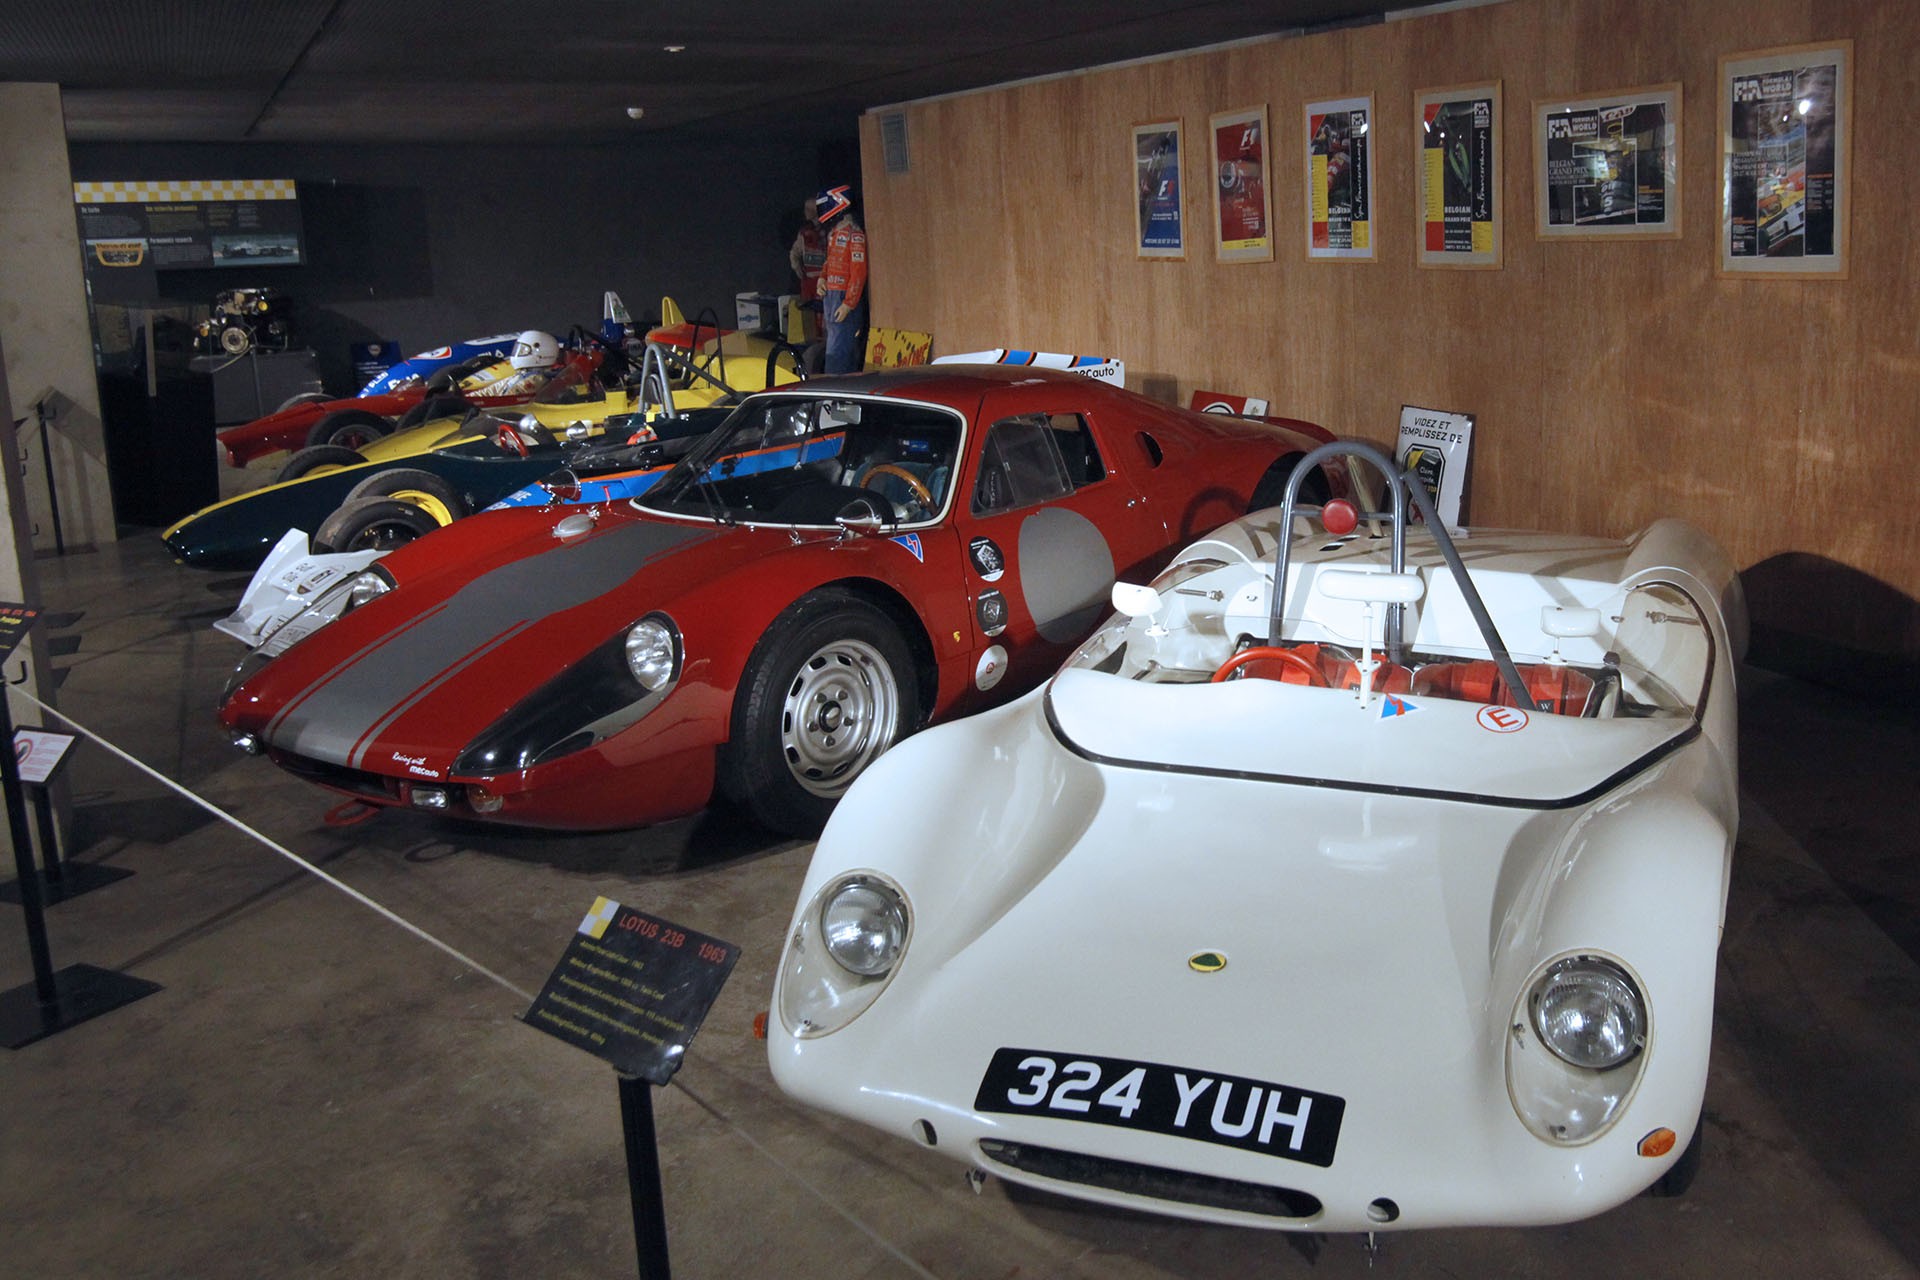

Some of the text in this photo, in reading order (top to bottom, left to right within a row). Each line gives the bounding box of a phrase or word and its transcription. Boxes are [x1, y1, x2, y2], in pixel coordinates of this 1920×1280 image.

[1734, 80, 1762, 102] FIA
[1762, 83, 1792, 92] WORLD
[1549, 118, 1573, 139] FIA
[1572, 123, 1597, 132] WORLD
[1444, 206, 1472, 214] BELGIAN
[1414, 417, 1452, 432] VIDEZ ET
[1449, 434, 1463, 446] DE
[1486, 707, 1520, 728] E
[618, 912, 728, 965] LOTUS 23B 1963
[1006, 1055, 1314, 1152] 324 YUH
